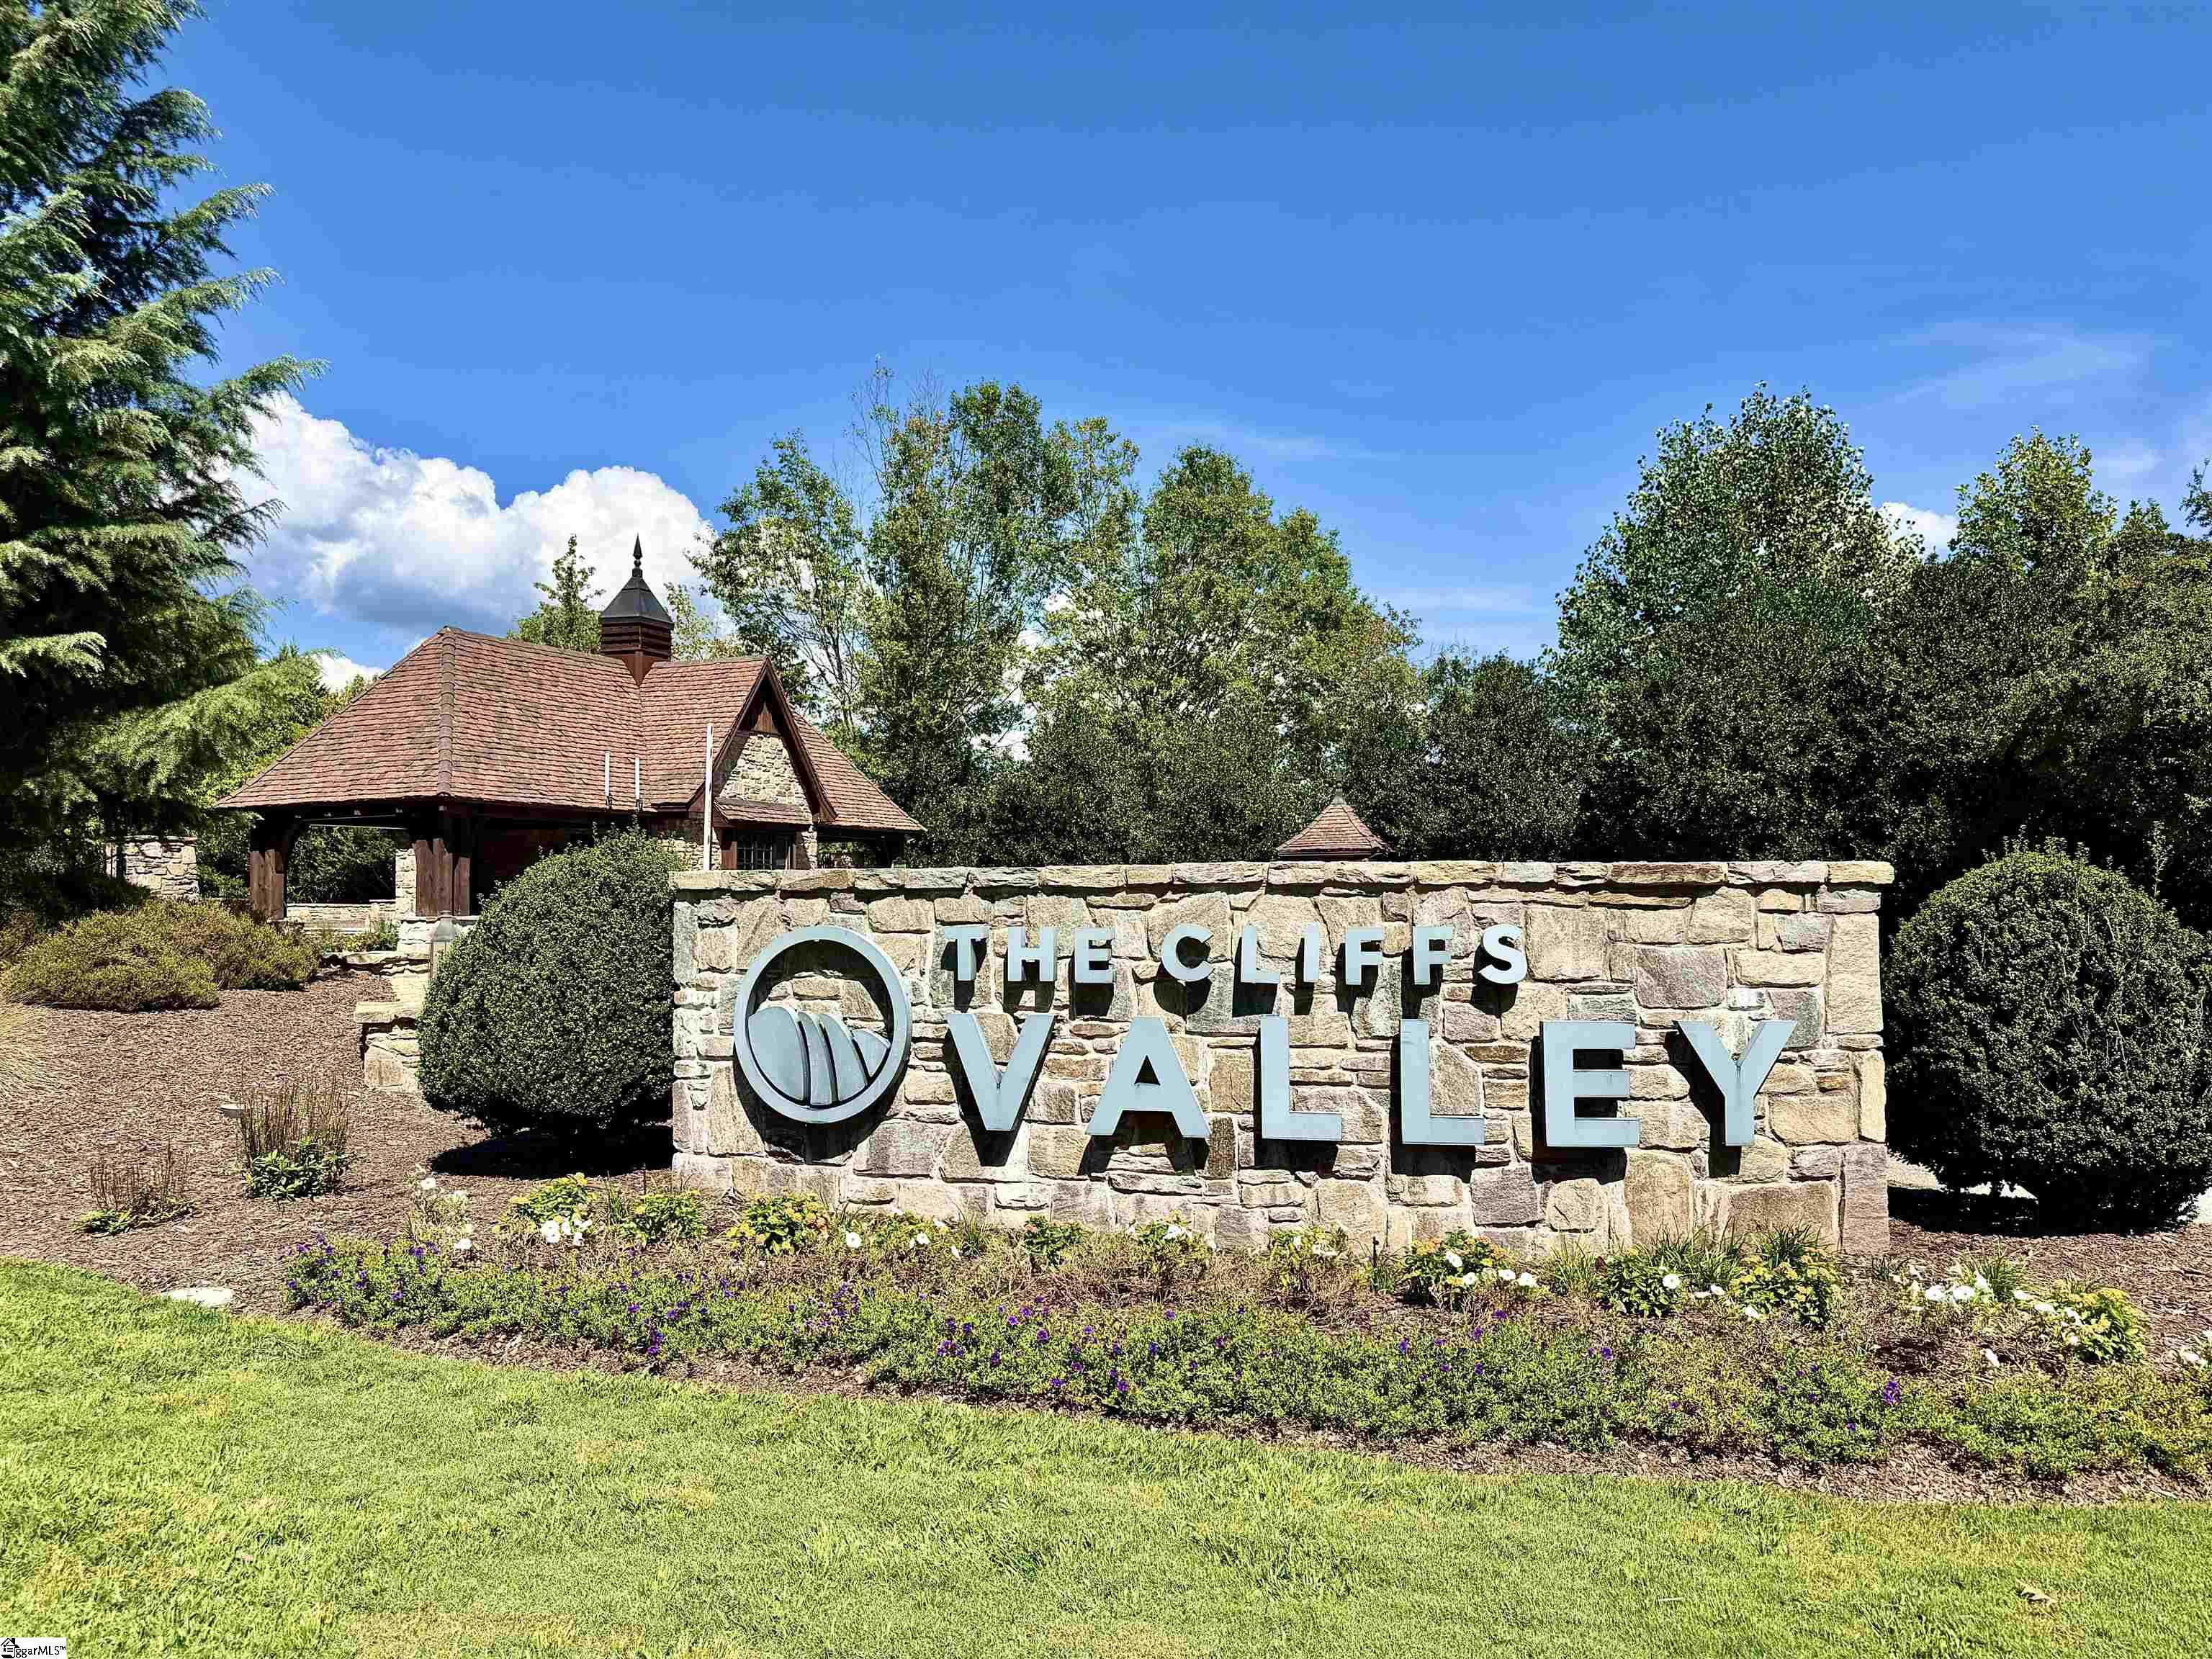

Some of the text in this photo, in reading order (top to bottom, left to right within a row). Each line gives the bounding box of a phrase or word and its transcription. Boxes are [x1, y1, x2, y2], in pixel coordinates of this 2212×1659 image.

[945, 923, 1529, 986] THE CLIFFS
[947, 1014, 1797, 1148] VALLEY
